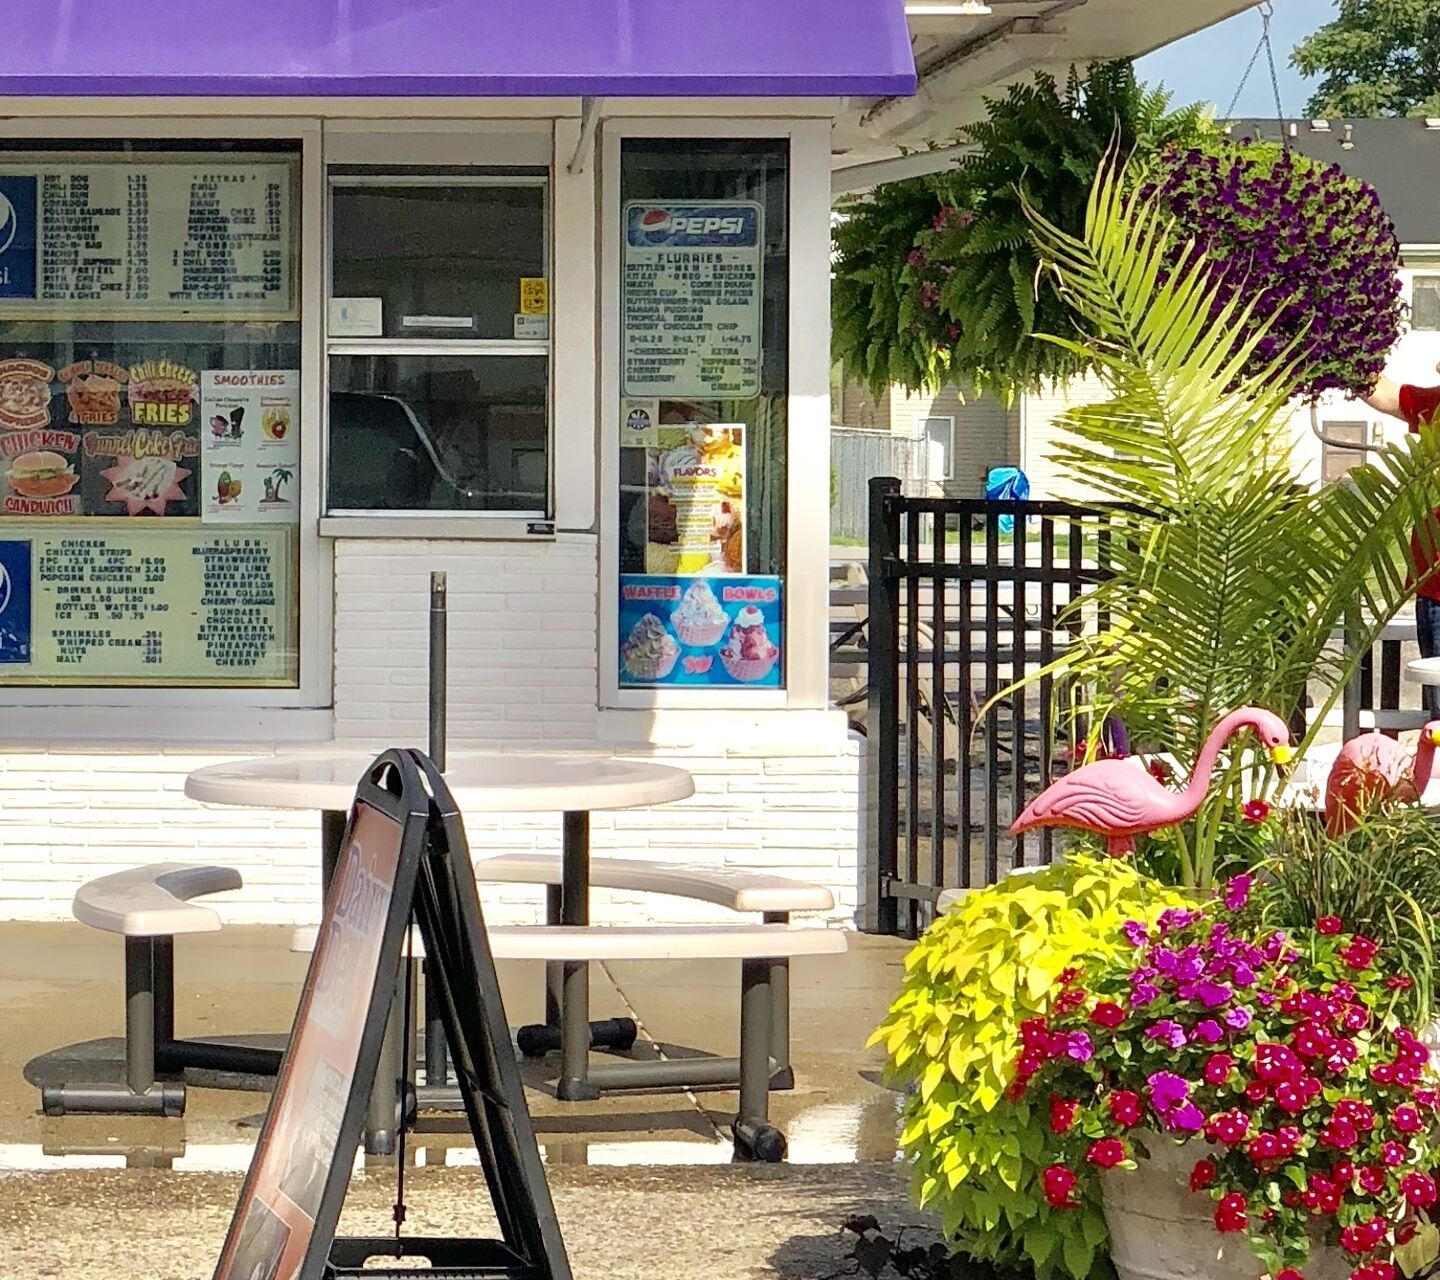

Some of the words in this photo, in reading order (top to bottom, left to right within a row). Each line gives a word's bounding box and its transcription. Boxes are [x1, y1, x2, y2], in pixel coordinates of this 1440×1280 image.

[669, 217, 744, 235] PEPSI
[214, 375, 286, 386] SMOOTHIES
[81, 411, 117, 423] FRIES
[133, 402, 191, 424] FRIES
[0, 431, 76, 455] CHICKEN
[673, 467, 718, 478] FLAVORS
[5, 499, 73, 514] SANDWICH
[61, 540, 106, 548] CHICKEN
[214, 539, 260, 547] SLUSH
[205, 556, 271, 564] STRAWBERRY
[91, 566, 141, 574] SANDWICH
[206, 564, 240, 572] LEMON
[246, 564, 268, 572] LIME
[236, 589, 274, 597] COLADA
[624, 586, 680, 600] WAFFLE
[723, 586, 777, 601] BOWLS
[56, 603, 97, 611] BOTTLED
[213, 608, 261, 616] SUNDAES
[206, 616, 268, 624] CHOCOLATE
[197, 633, 275, 641] BUTTERSCOTCH
[207, 641, 266, 649] PINEAPPLE
[60, 647, 87, 655] NUTS
[205, 650, 266, 658] BLUEBERRY
